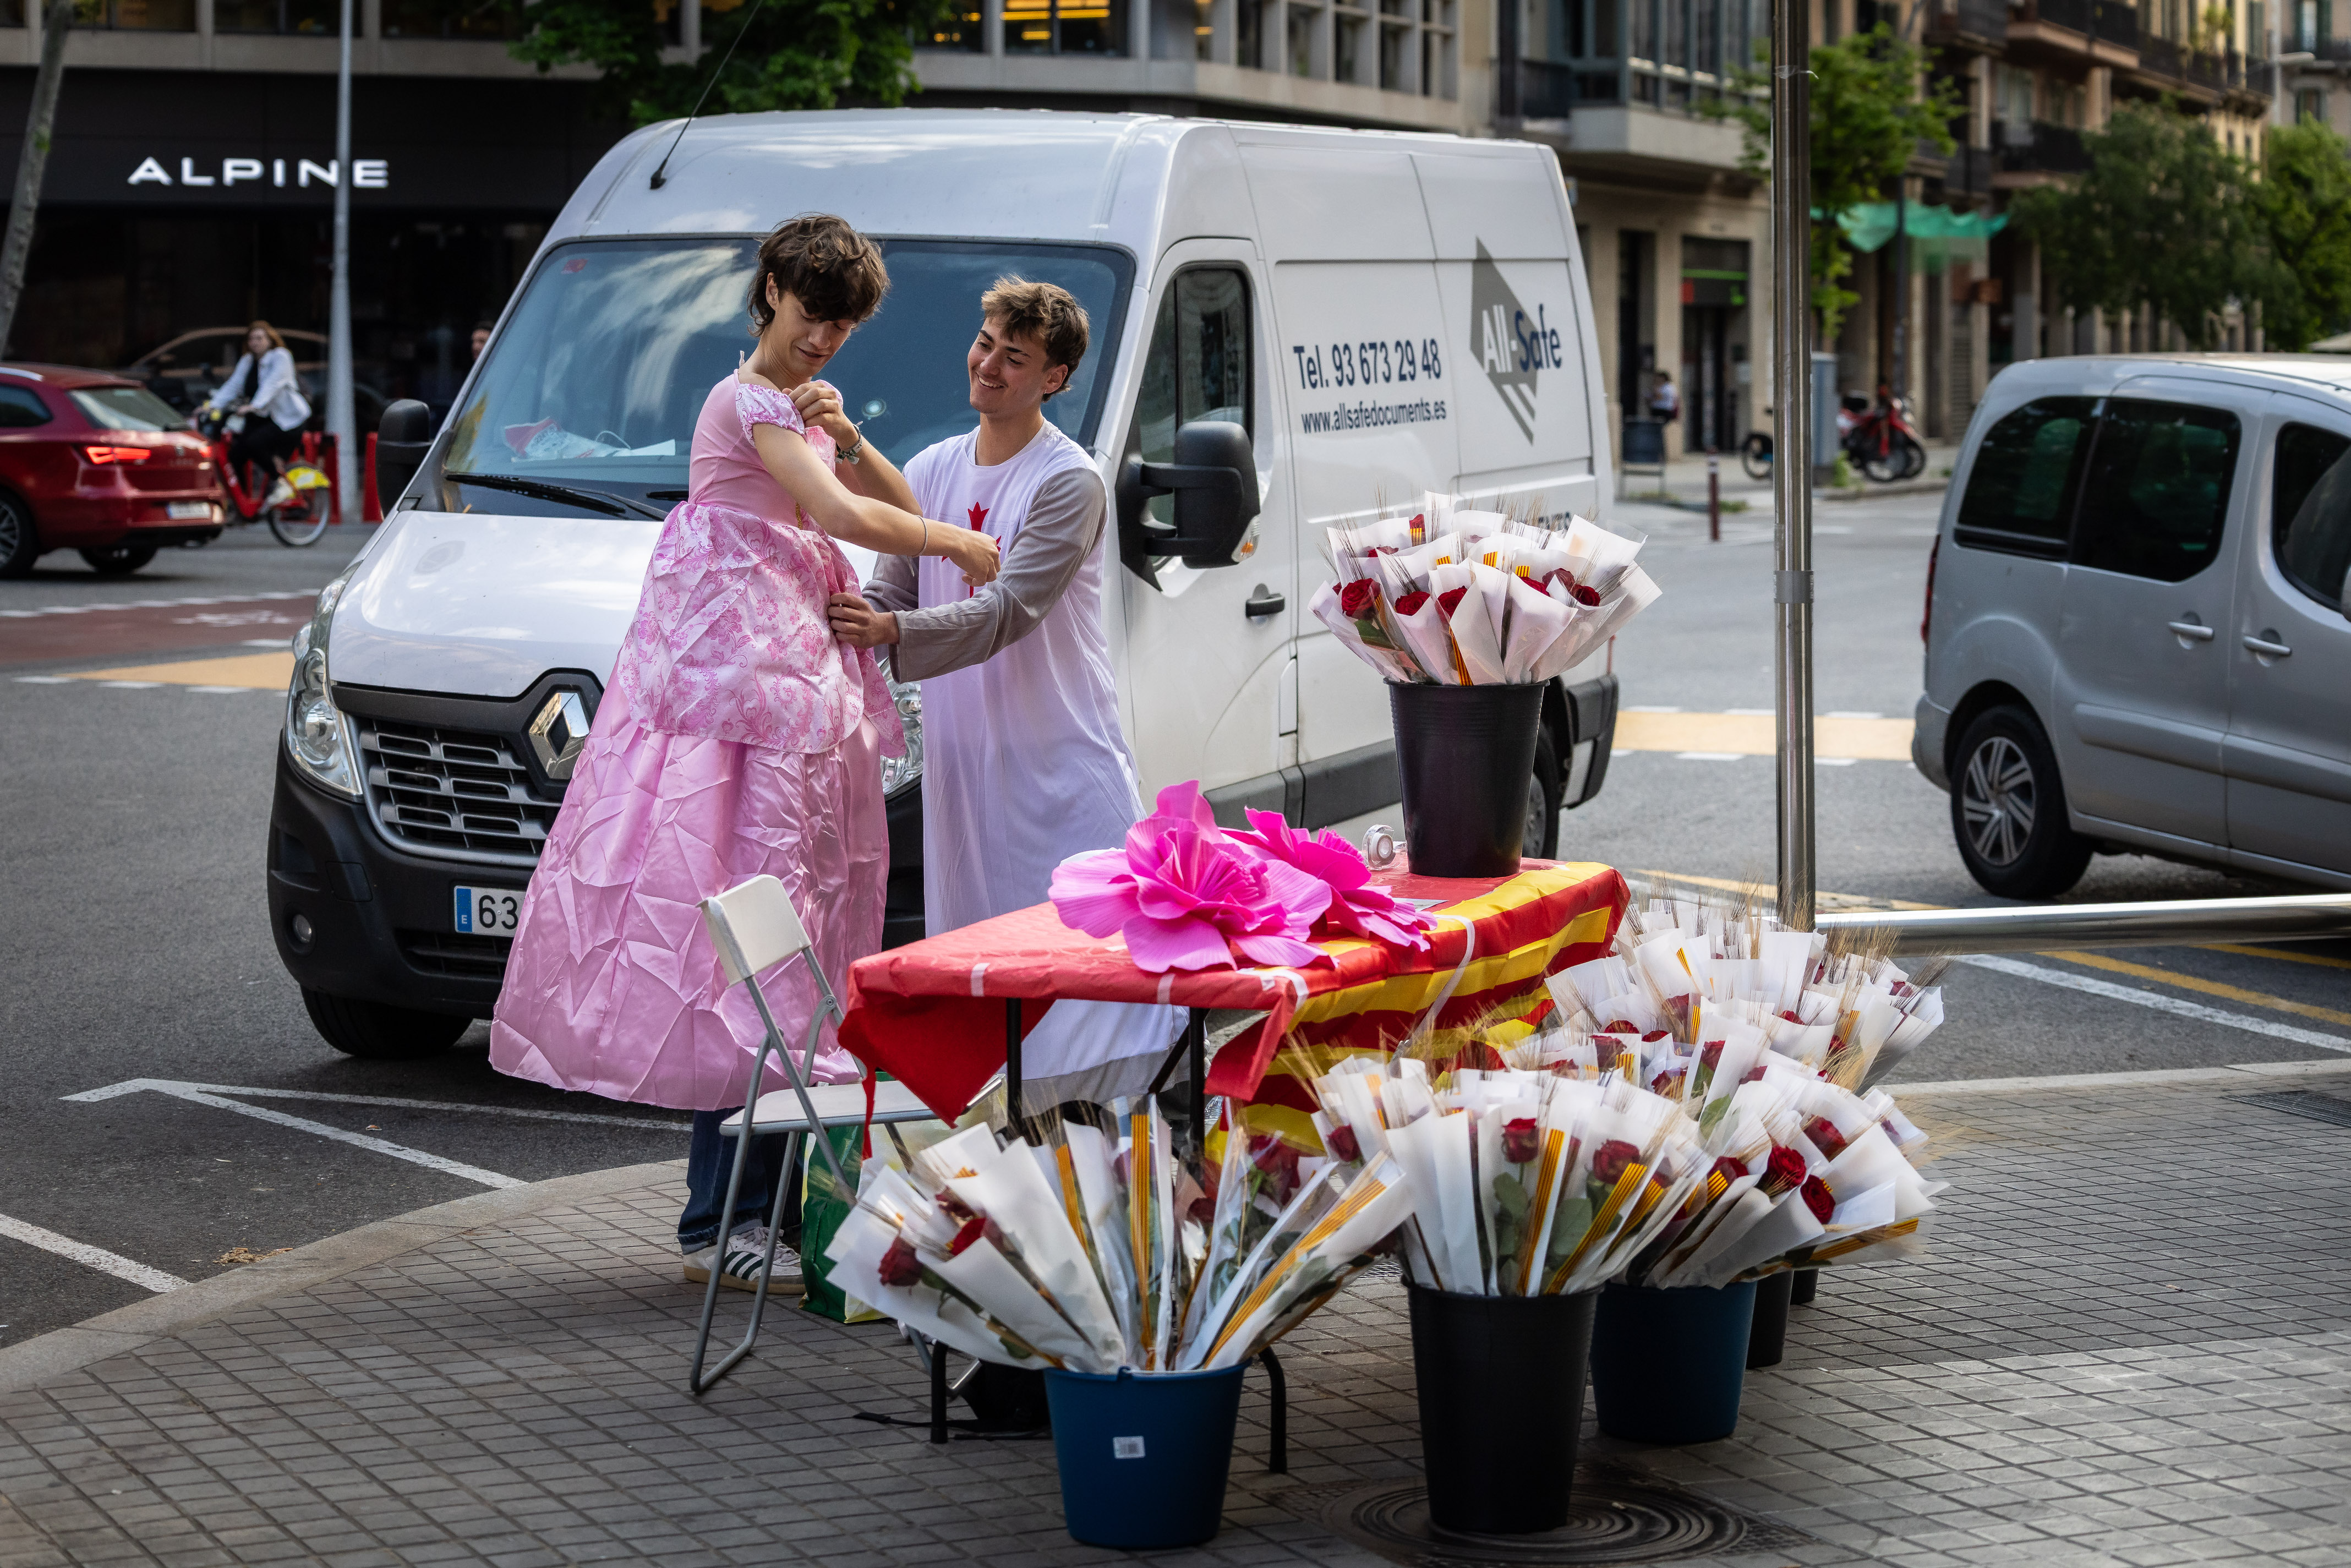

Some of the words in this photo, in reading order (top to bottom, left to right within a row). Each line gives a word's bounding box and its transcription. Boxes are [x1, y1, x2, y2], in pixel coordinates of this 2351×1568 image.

[127, 156, 388, 188] ALPINE
[1293, 345, 1329, 390] Tel.
[1332, 343, 1355, 387] 93
[1359, 341, 1391, 385] 673
[1395, 340, 1417, 381] 29
[1421, 338, 1442, 380] 48
[1301, 397, 1447, 434] www.allsafedocuments.es
[461, 914, 468, 925] E
